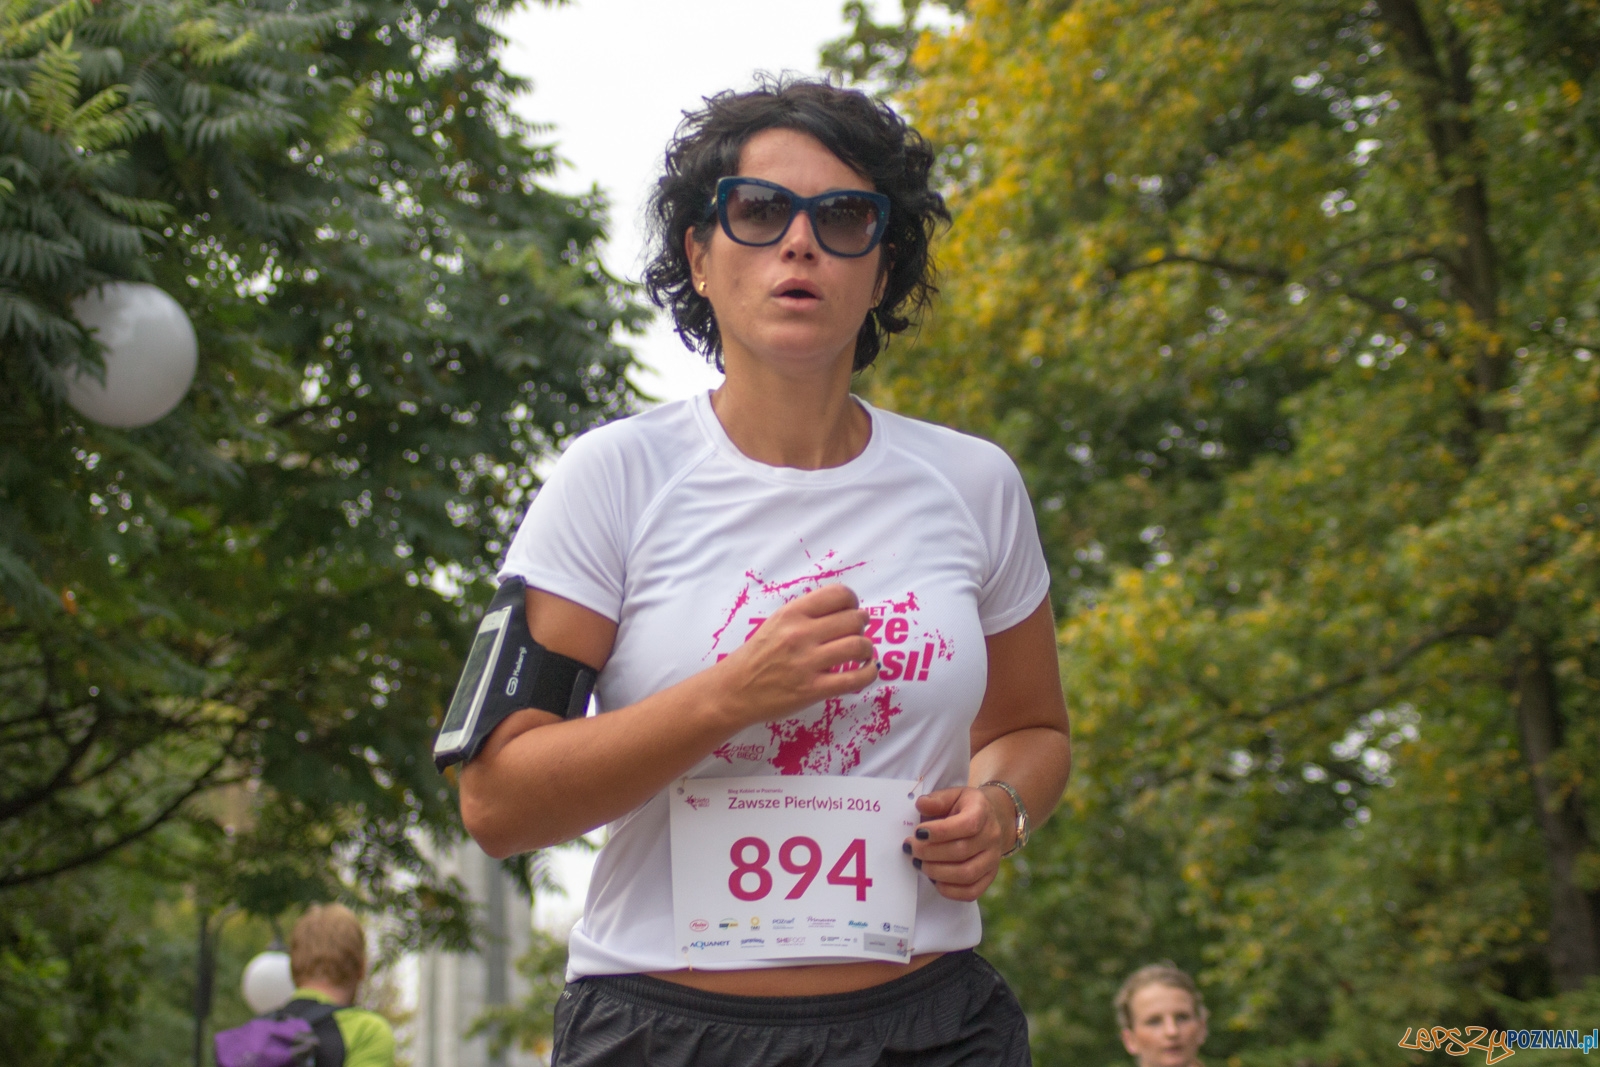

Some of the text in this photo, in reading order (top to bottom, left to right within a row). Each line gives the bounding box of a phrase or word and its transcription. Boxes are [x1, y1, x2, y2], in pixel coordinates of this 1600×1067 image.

[728, 795, 881, 812] Zawsze Pier(w)si 2016
[728, 836, 873, 902] 894
